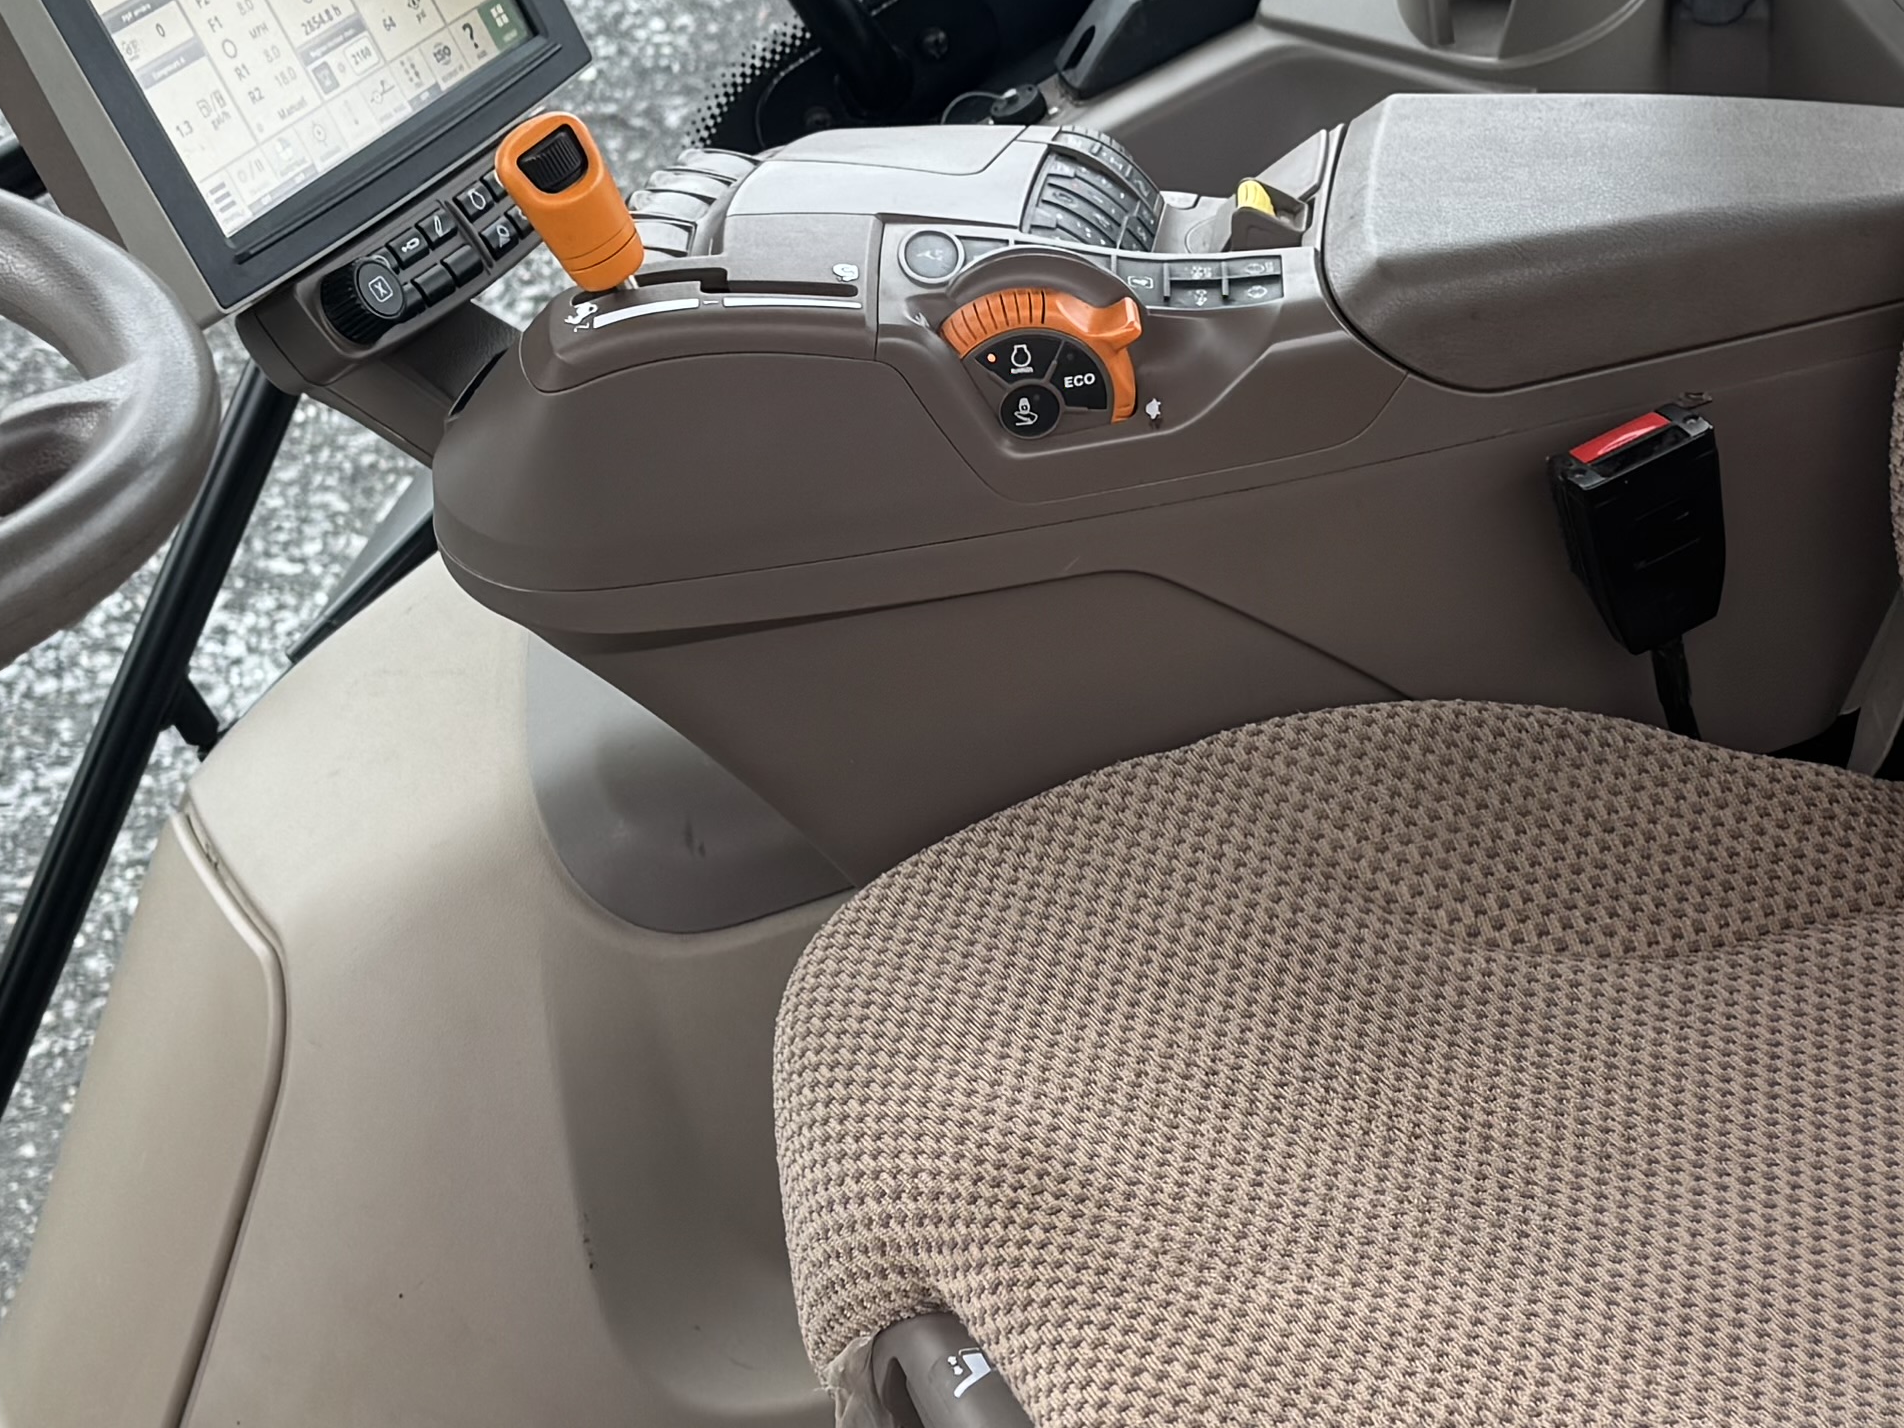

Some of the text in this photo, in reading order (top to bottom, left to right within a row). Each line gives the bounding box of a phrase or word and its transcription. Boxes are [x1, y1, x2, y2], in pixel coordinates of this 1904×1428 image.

[207, 15, 223, 32] F1
[233, 63, 250, 81] R1
[247, 86, 264, 104] R2
[1064, 372, 1095, 388] ECO
